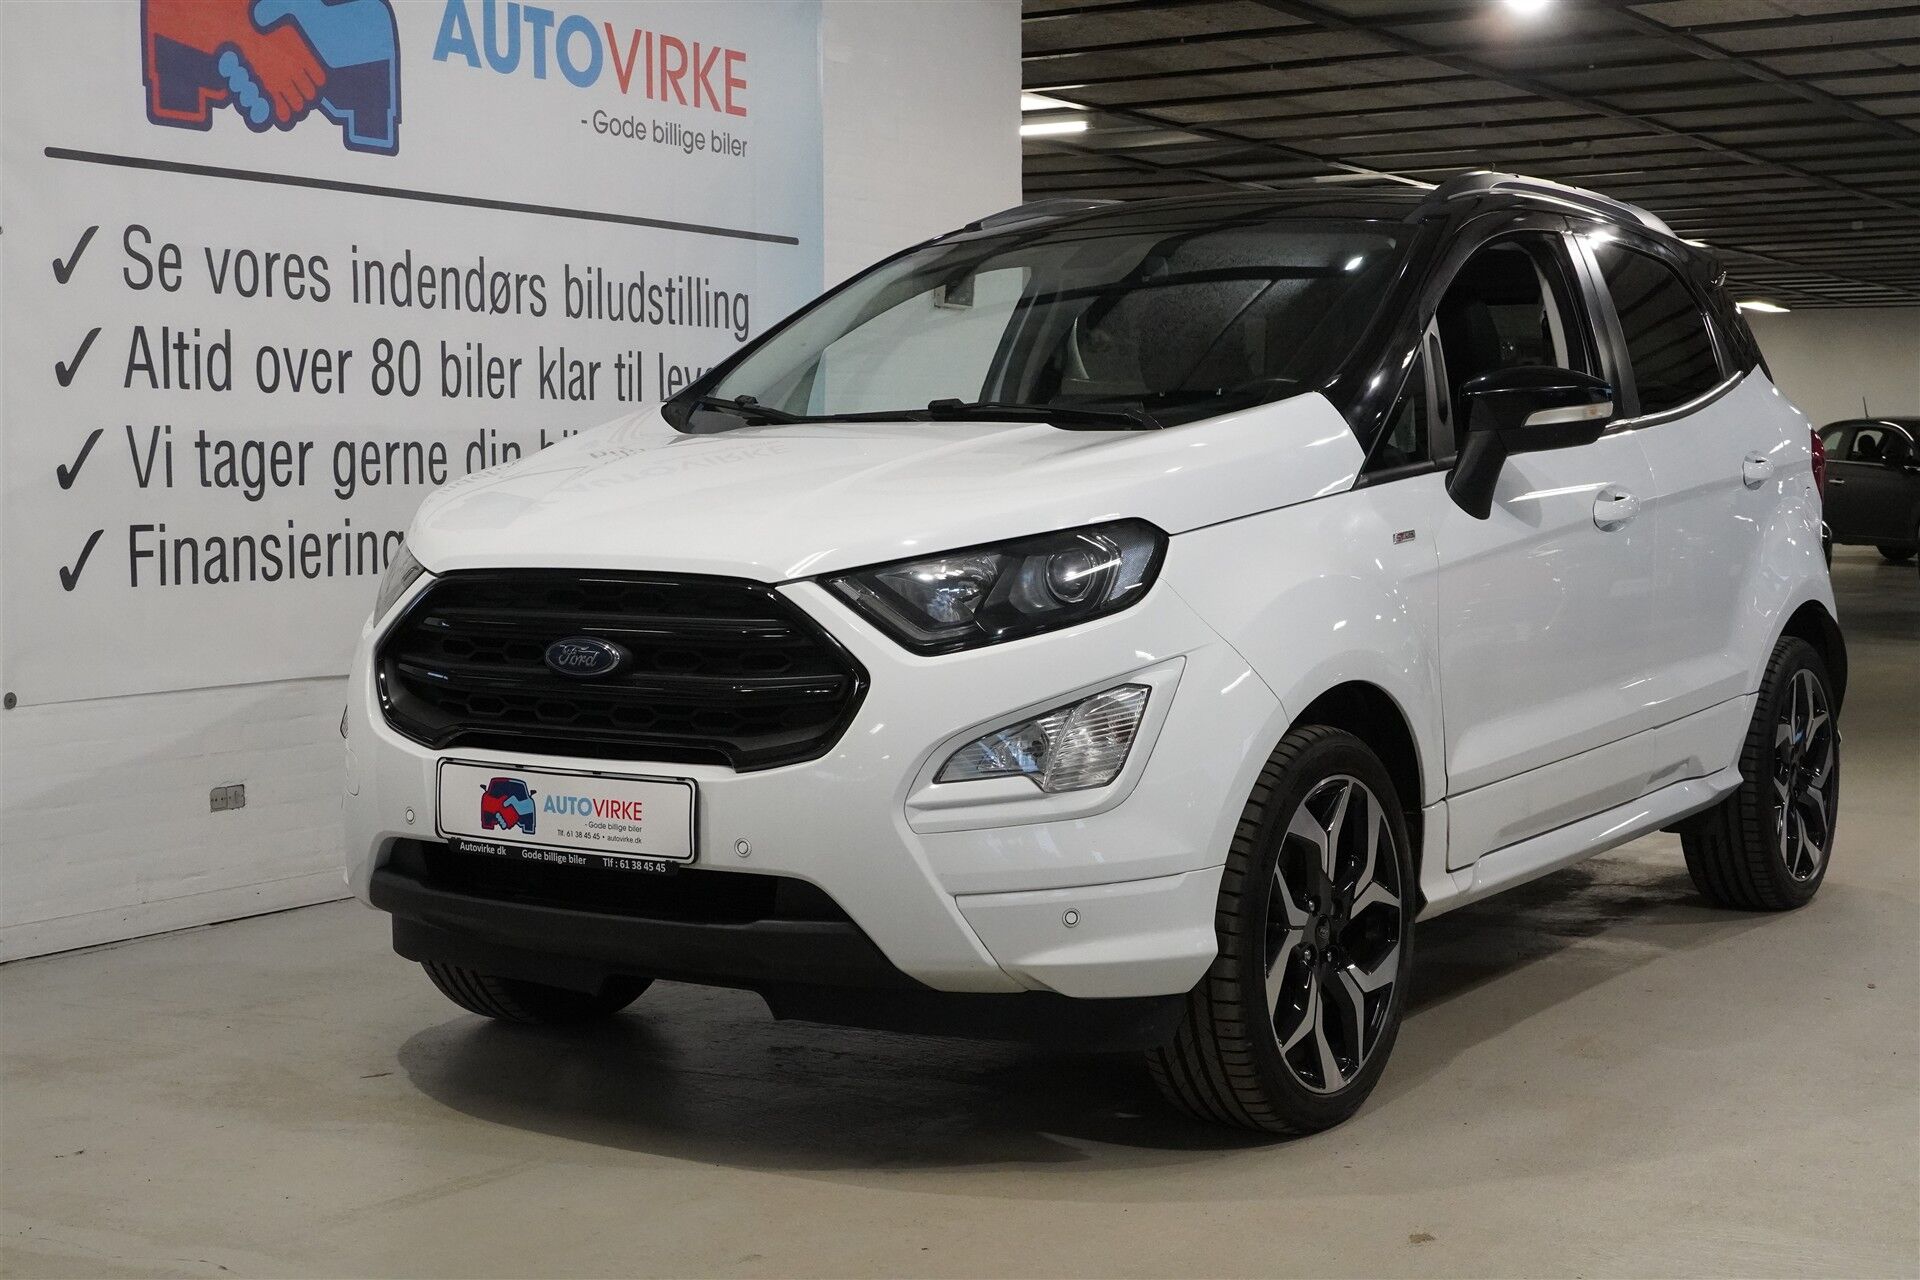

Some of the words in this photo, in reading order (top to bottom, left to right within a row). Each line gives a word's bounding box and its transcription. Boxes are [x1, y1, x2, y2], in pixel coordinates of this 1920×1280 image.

[433, 0, 748, 117] AUTOVIRKE
[592, 109, 647, 141] Gode
[652, 119, 706, 155] billige
[711, 129, 748, 158] biler
[123, 224, 182, 293] Se
[204, 247, 331, 303] vores
[351, 244, 547, 318] indendørs
[564, 263, 749, 343] biludstilling
[123, 325, 232, 392] Altid
[256, 345, 353, 395] over
[371, 337, 421, 398] 80
[440, 340, 523, 400] biler
[537, 345, 602, 402] klar
[614, 350, 643, 402] til
[125, 424, 173, 489] Vi
[194, 429, 314, 502] tager
[333, 440, 448, 501] gerne
[558, 644, 601, 667] Ford
[543, 795, 643, 821] AUTOVIRKE
[588, 821, 606, 829] Gode
[628, 825, 642, 833] biler
[460, 842, 495, 855] Autovirke
[521, 849, 542, 860] Gode
[543, 851, 567, 864] billige
[568, 854, 587, 865] biler
[620, 859, 630, 869] 61
[631, 860, 642, 870] 38
[643, 862, 654, 872] 45
[655, 863, 666, 873] 45
